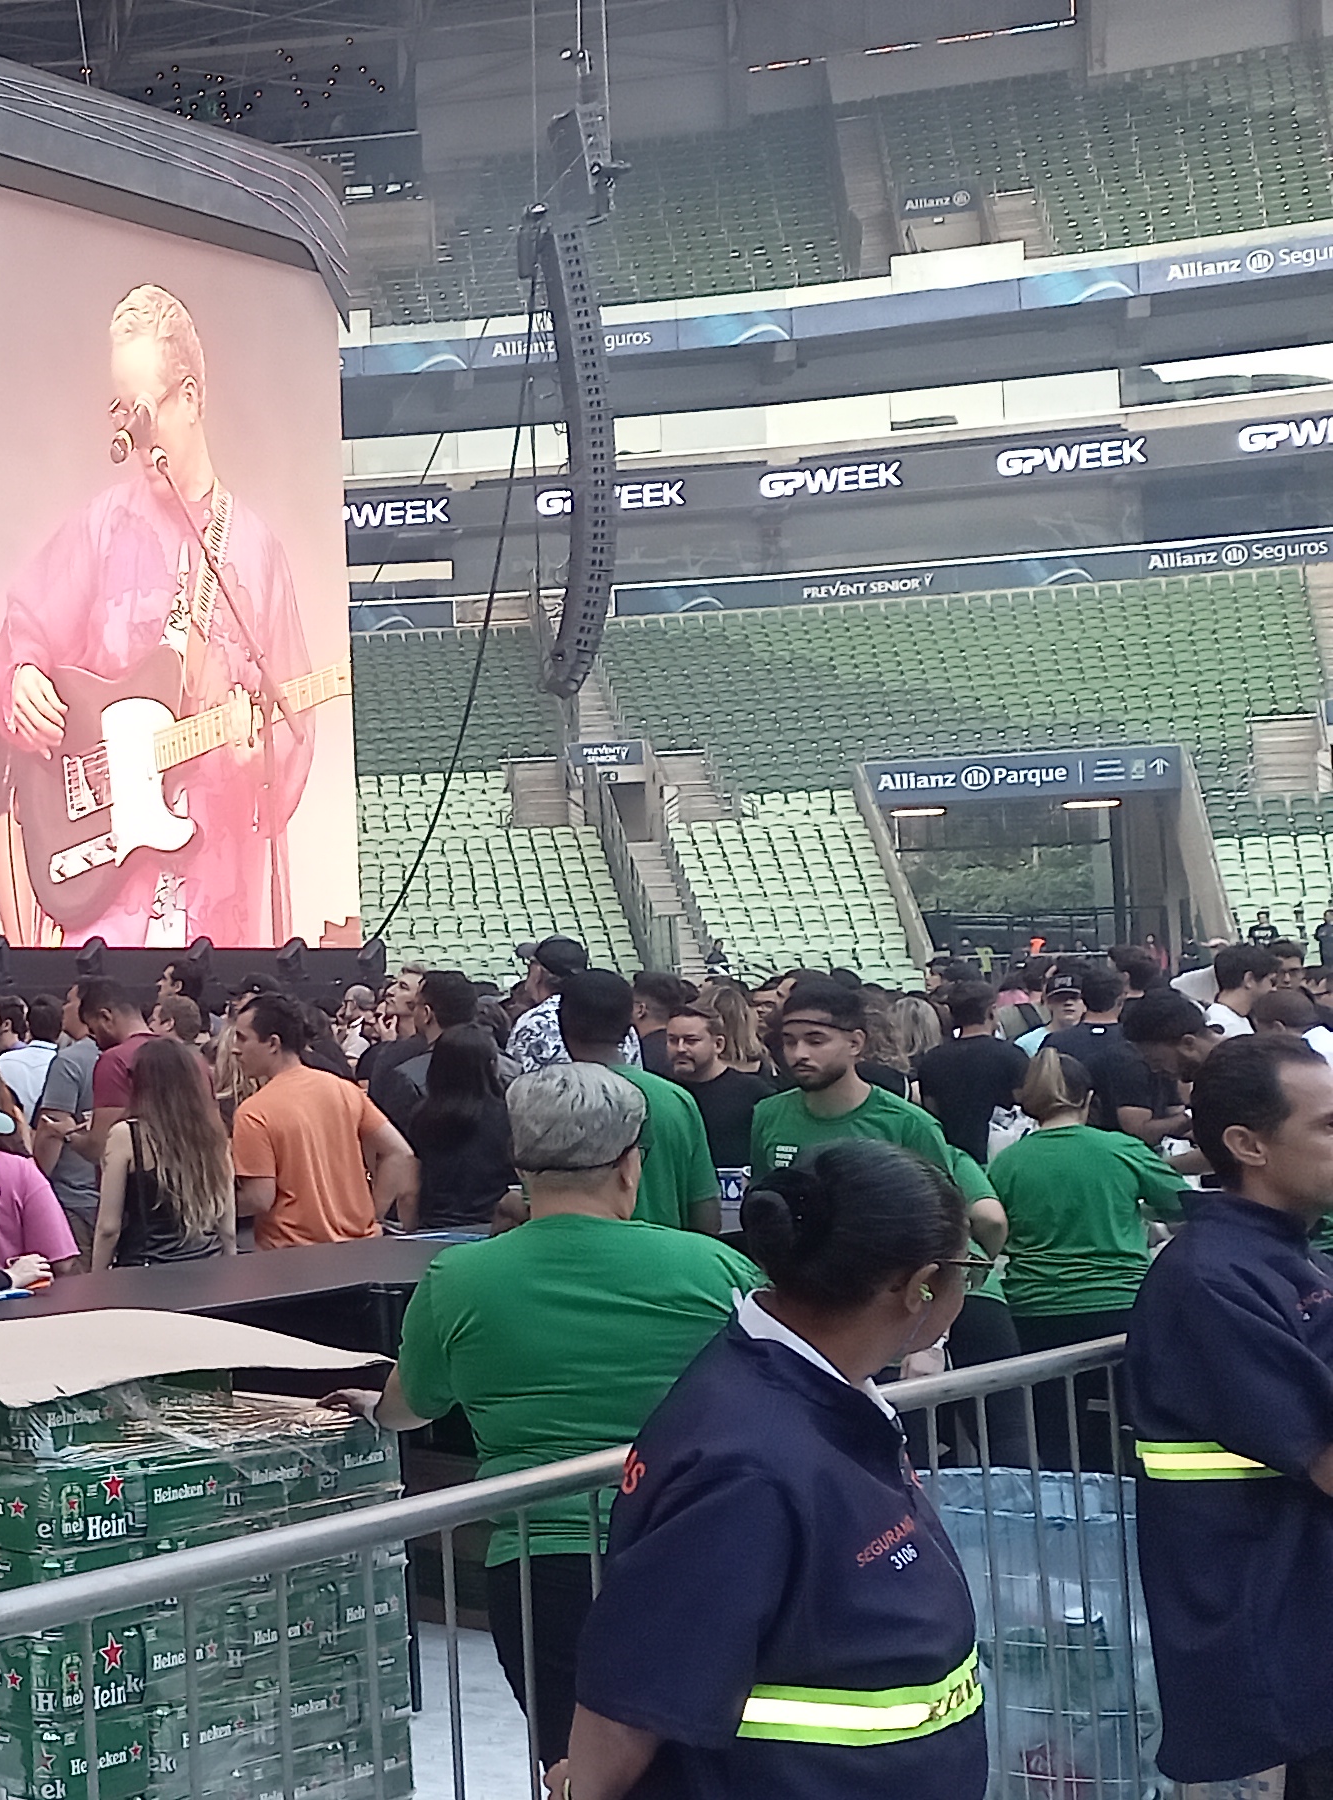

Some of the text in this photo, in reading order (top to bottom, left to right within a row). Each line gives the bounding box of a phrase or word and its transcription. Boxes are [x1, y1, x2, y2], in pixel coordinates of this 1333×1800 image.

[905, 196, 951, 210] Allianz
[1167, 258, 1242, 281] Allianz
[492, 331, 652, 358] Allianz guros
[996, 437, 1146, 476] GPWEEK
[759, 461, 902, 498] GPWEEK
[1148, 540, 1329, 570] Allianz Seguros
[802, 578, 921, 599] PREVENT SENIOR
[877, 769, 956, 792] Allianz
[993, 763, 1068, 790] Parque
[153, 1479, 204, 1504] Heineken
[890, 1543, 918, 1570] 3106
[253, 1621, 302, 1646] Heinen
[153, 1643, 204, 1671] Heinen
[289, 1701, 328, 1719] eineken
[70, 1748, 128, 1776] Heeken
